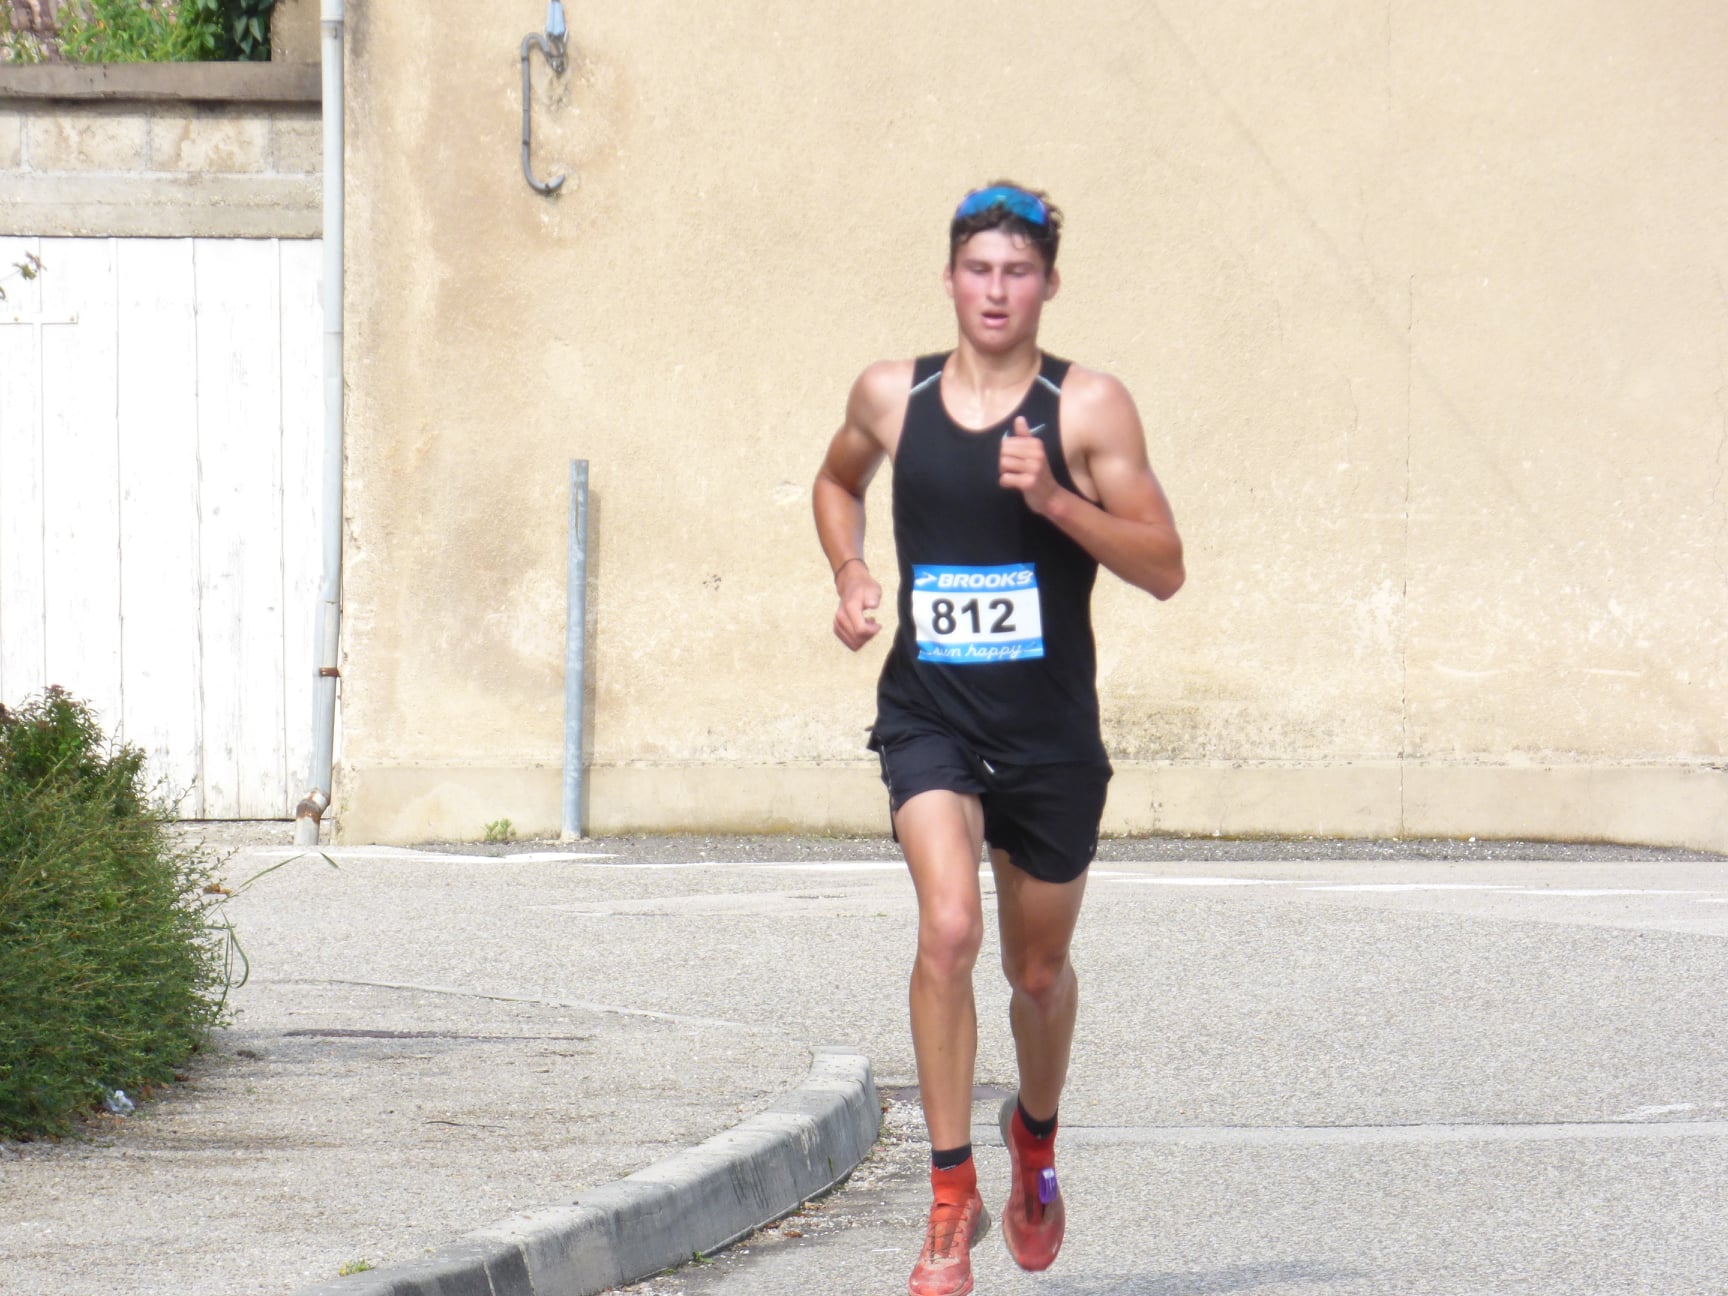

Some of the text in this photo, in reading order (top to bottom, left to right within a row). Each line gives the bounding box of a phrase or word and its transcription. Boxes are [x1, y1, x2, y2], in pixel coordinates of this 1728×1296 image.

[938, 570, 1034, 588] BROOKS
[931, 597, 1016, 635] 812
[964, 643, 1022, 660] happy
